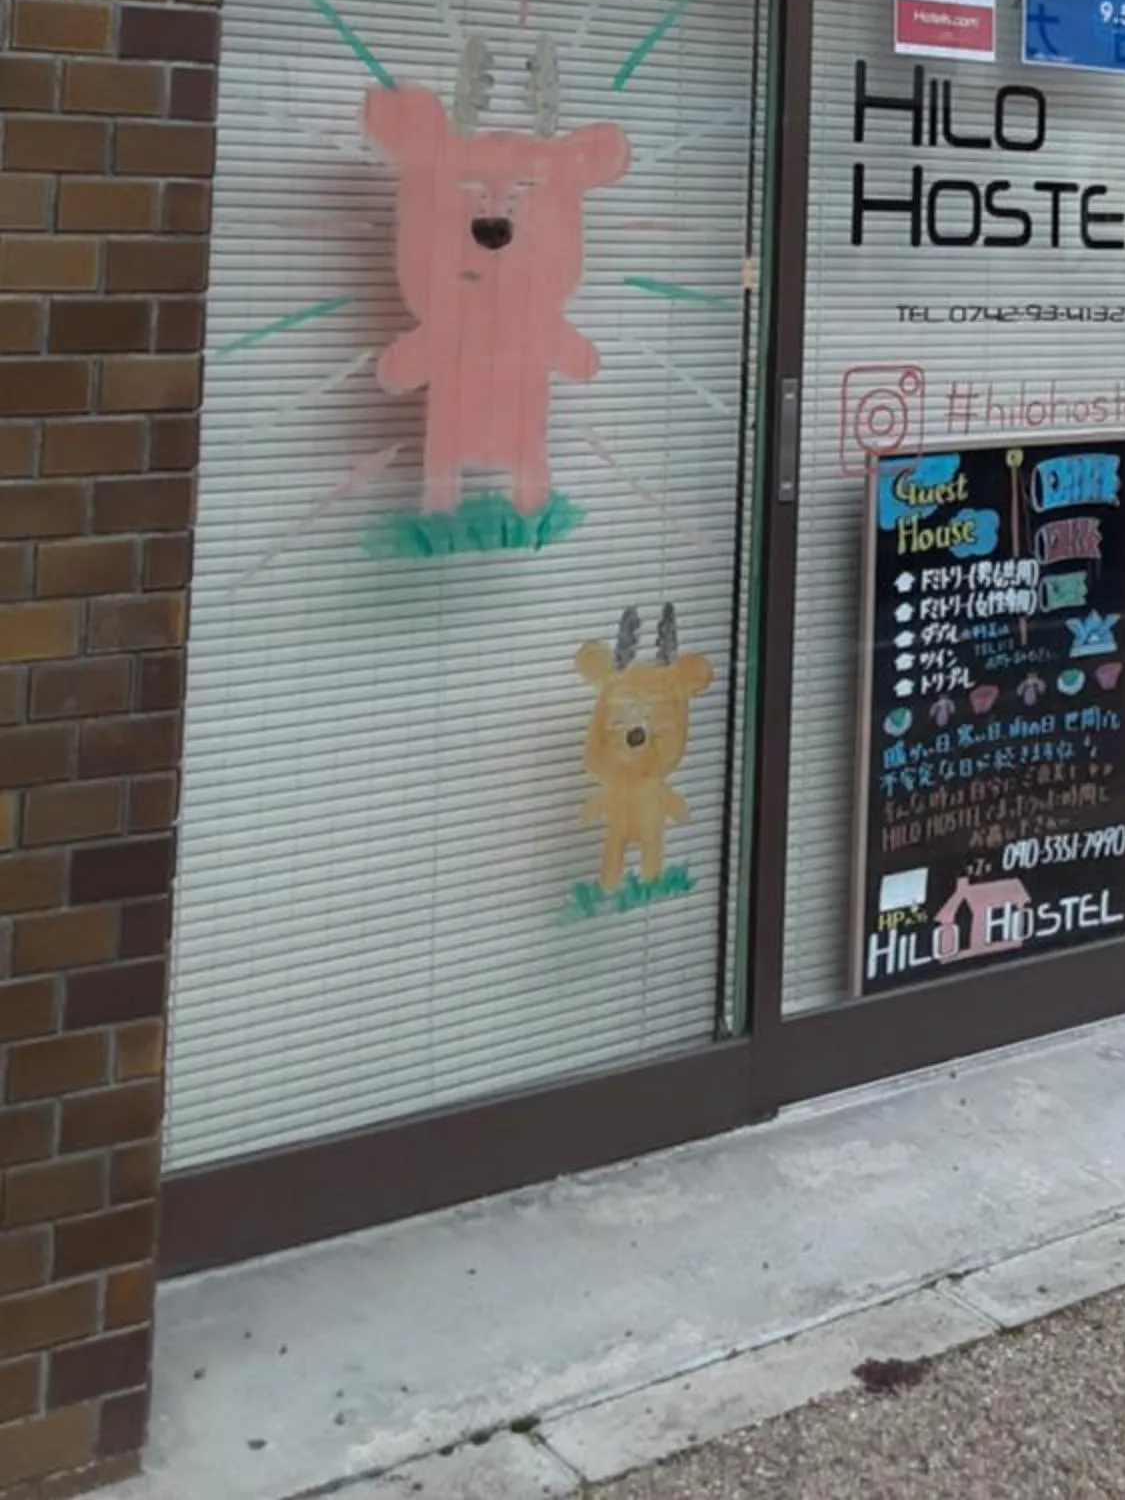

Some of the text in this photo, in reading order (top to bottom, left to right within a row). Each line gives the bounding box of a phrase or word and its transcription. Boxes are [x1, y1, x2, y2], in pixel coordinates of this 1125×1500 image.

[853, 60, 1047, 152] HILO
[895, 472, 969, 505] Guest
[897, 514, 976, 555] House
[867, 923, 960, 979] HILO
[984, 887, 1125, 945] HOSTEL
